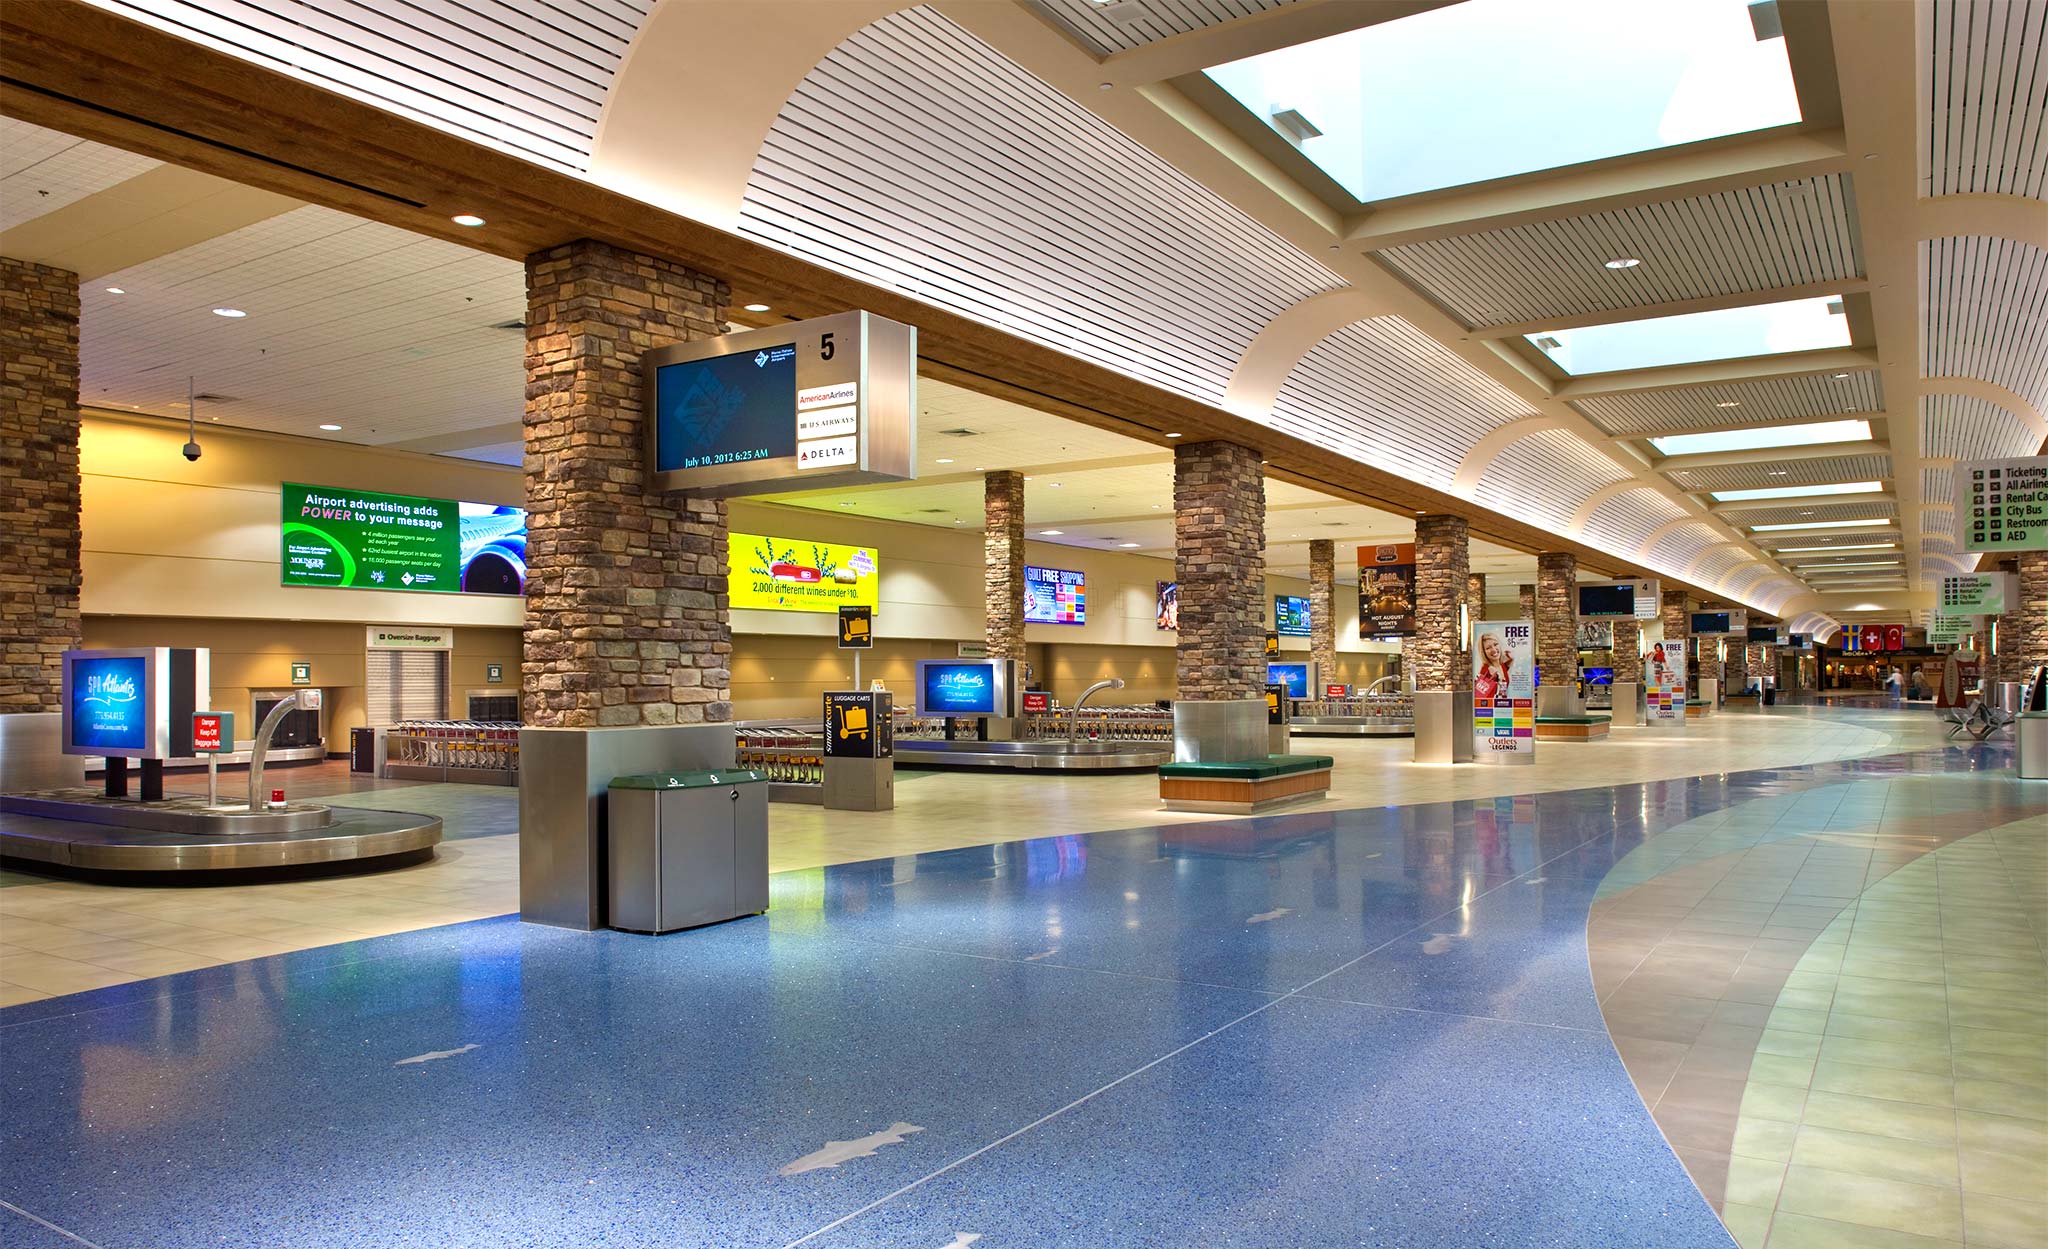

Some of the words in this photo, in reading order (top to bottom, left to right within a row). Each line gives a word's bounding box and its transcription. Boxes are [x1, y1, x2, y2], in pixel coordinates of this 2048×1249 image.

[821, 333, 835, 361] 5
[685, 456, 699, 469] July
[701, 455, 713, 466] 10,
[714, 452, 734, 464] 2012
[735, 450, 752, 461] 6:25
[754, 448, 769, 459] AM
[811, 447, 844, 459] DELTA
[2006, 466, 2047, 478] Ticketing
[2006, 480, 2019, 491] All
[2006, 492, 2035, 503] Rental
[305, 494, 346, 508] Airport
[350, 499, 410, 516] advertising
[413, 506, 439, 516] adds
[2006, 505, 2025, 517] City
[2026, 505, 2042, 515] Bus
[301, 506, 352, 521] POWER
[354, 511, 366, 521] to
[369, 513, 394, 525] your
[397, 516, 443, 530] message
[2007, 531, 2027, 541] AED
[1042, 569, 1060, 583] FREE
[752, 582, 774, 594] 2,000
[775, 584, 805, 595] different
[806, 587, 826, 597] wines
[827, 588, 846, 598] under
[1642, 583, 1648, 591] 4
[1505, 626, 1529, 637] FREE
[415, 634, 441, 642] Baggage
[1666, 643, 1682, 651] FREE
[102, 673, 135, 697] Atlantis
[201, 718, 216, 727] Danger
[200, 729, 210, 737] Keep
[195, 739, 211, 747] Baggage
[1488, 737, 1518, 745] Outlets
